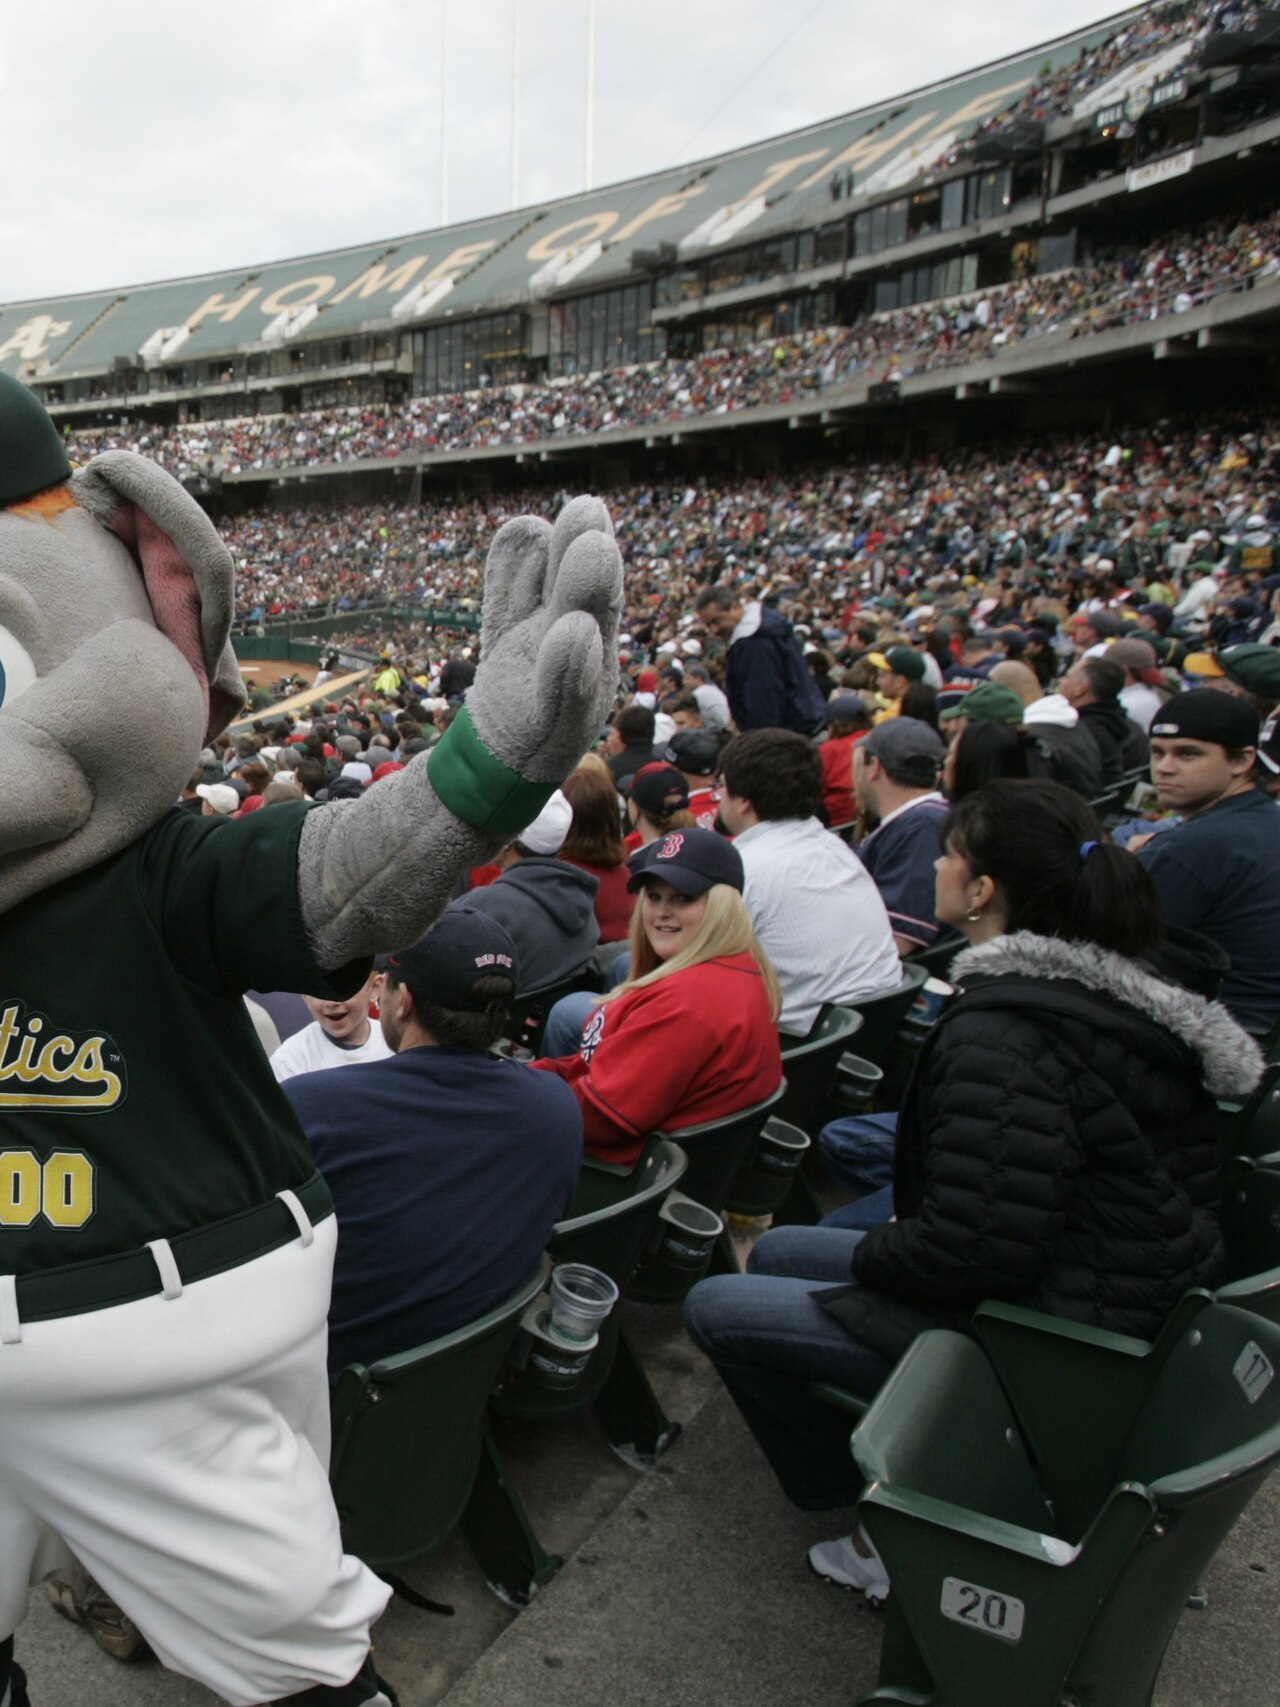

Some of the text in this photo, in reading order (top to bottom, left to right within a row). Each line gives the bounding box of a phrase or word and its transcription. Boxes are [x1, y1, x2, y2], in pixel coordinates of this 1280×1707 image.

[185, 239, 497, 329] HOME
[525, 184, 706, 261] OF
[656, 833, 685, 859] B
[474, 953, 496, 968] RED
[1241, 1353, 1268, 1388] 17
[956, 1585, 1008, 1631] 20
